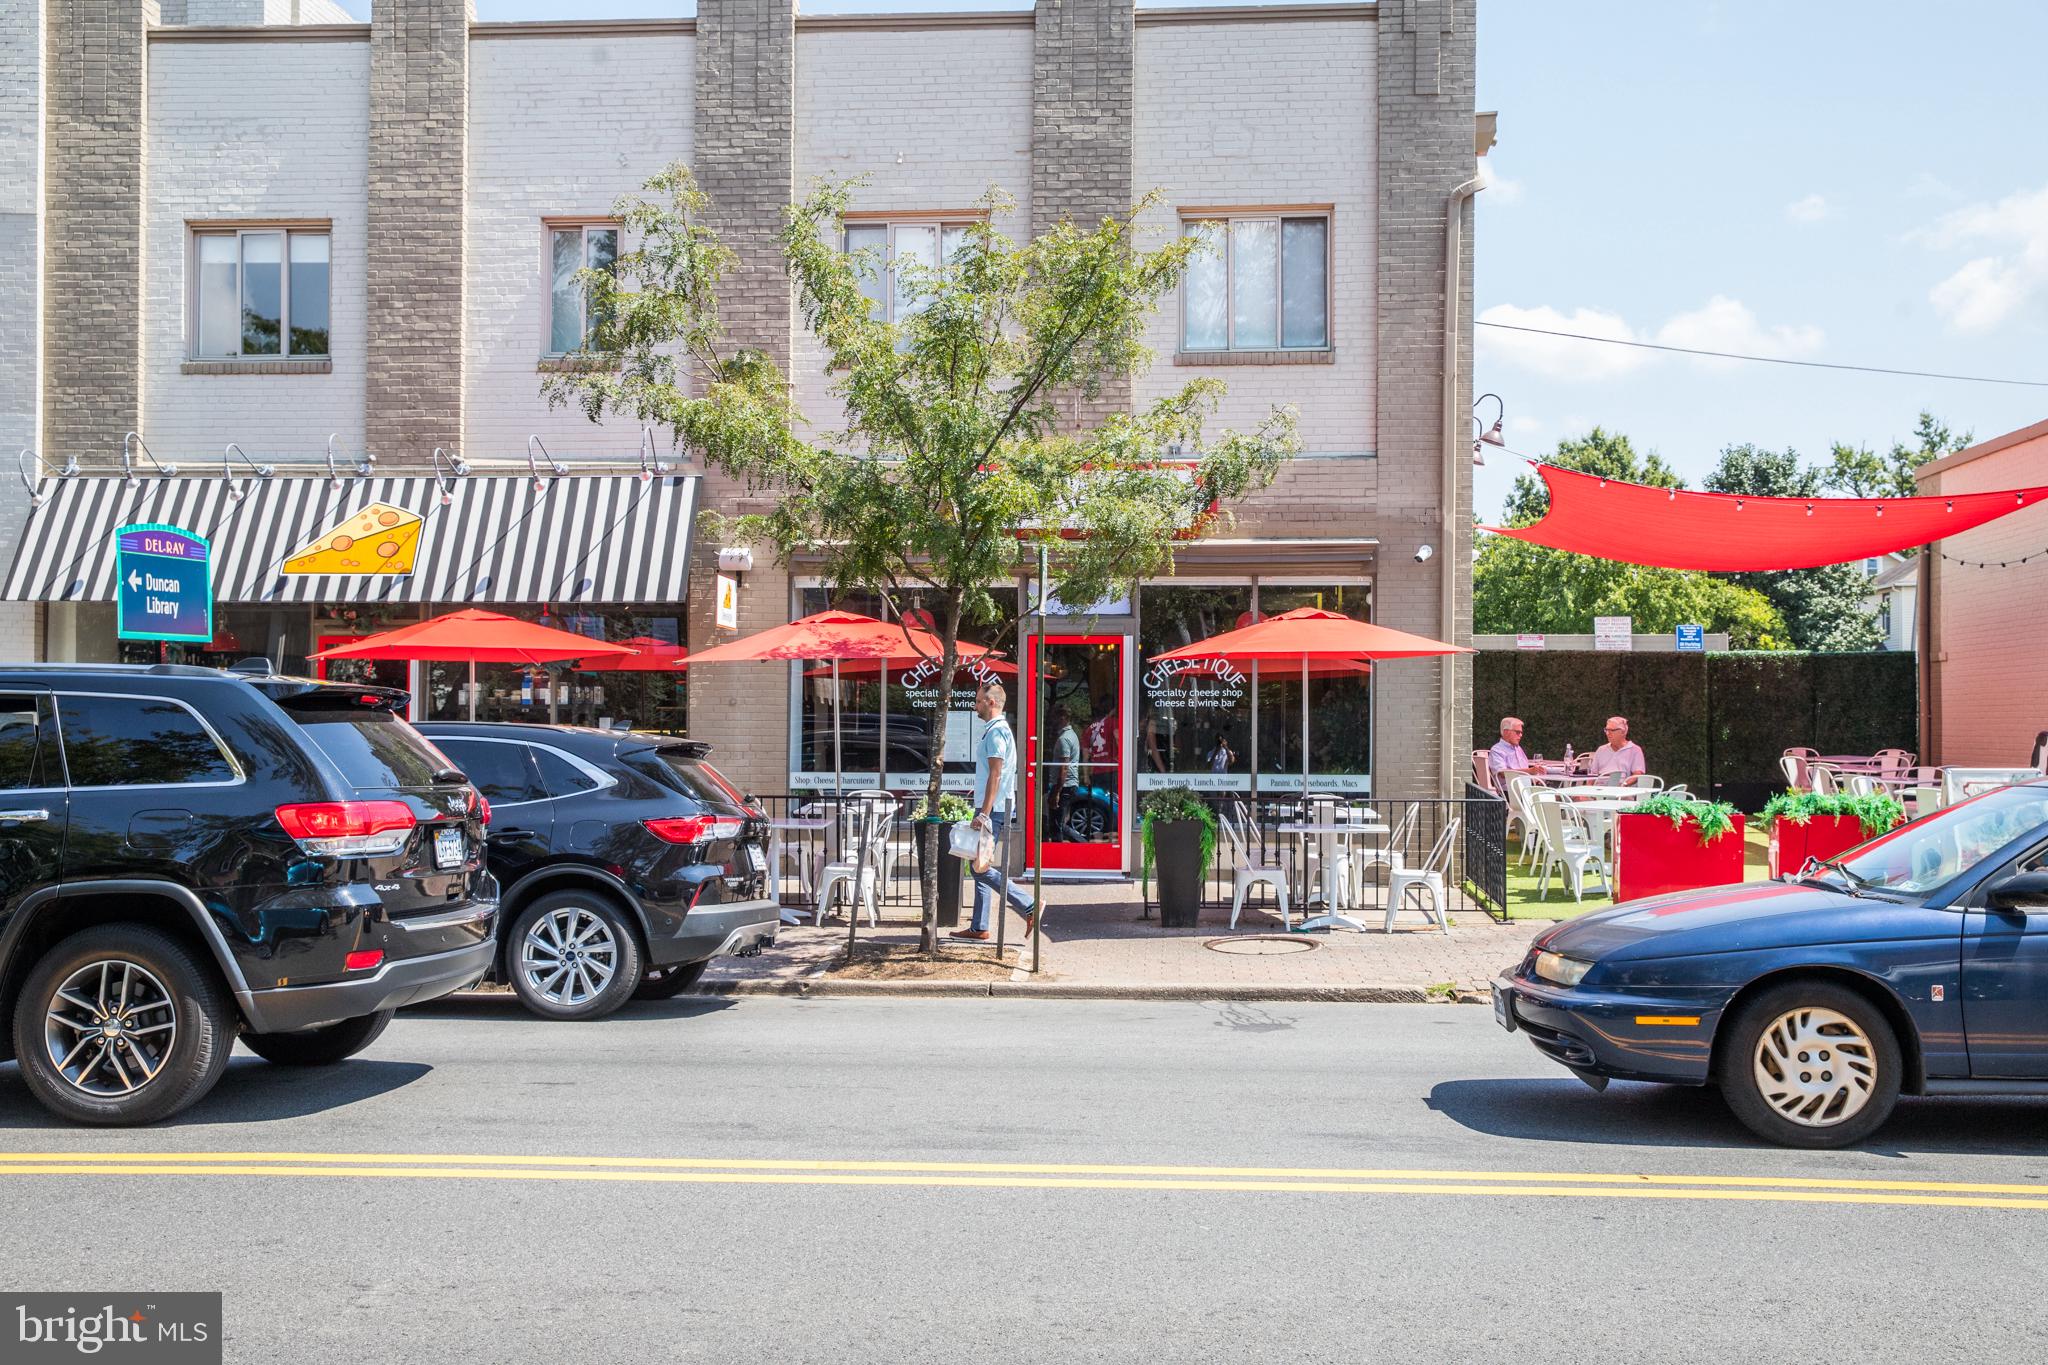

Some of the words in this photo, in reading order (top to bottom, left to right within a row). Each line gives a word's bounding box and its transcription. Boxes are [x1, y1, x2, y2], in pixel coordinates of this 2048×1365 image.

[146, 573, 180, 593] Duncan
[146, 596, 179, 619] Library
[905, 689, 940, 699] specialt
[949, 689, 976, 698] heese
[1147, 689, 1187, 698] specialty
[1189, 689, 1220, 697] cheese
[1222, 688, 1243, 698] shop
[912, 699, 938, 708] chees
[954, 699, 976, 708] wine
[1154, 699, 1186, 708] cheese
[1188, 699, 1195, 708] &
[1198, 699, 1219, 708] wine
[1221, 699, 1237, 708] bar
[374, 883, 401, 892] 4x4
